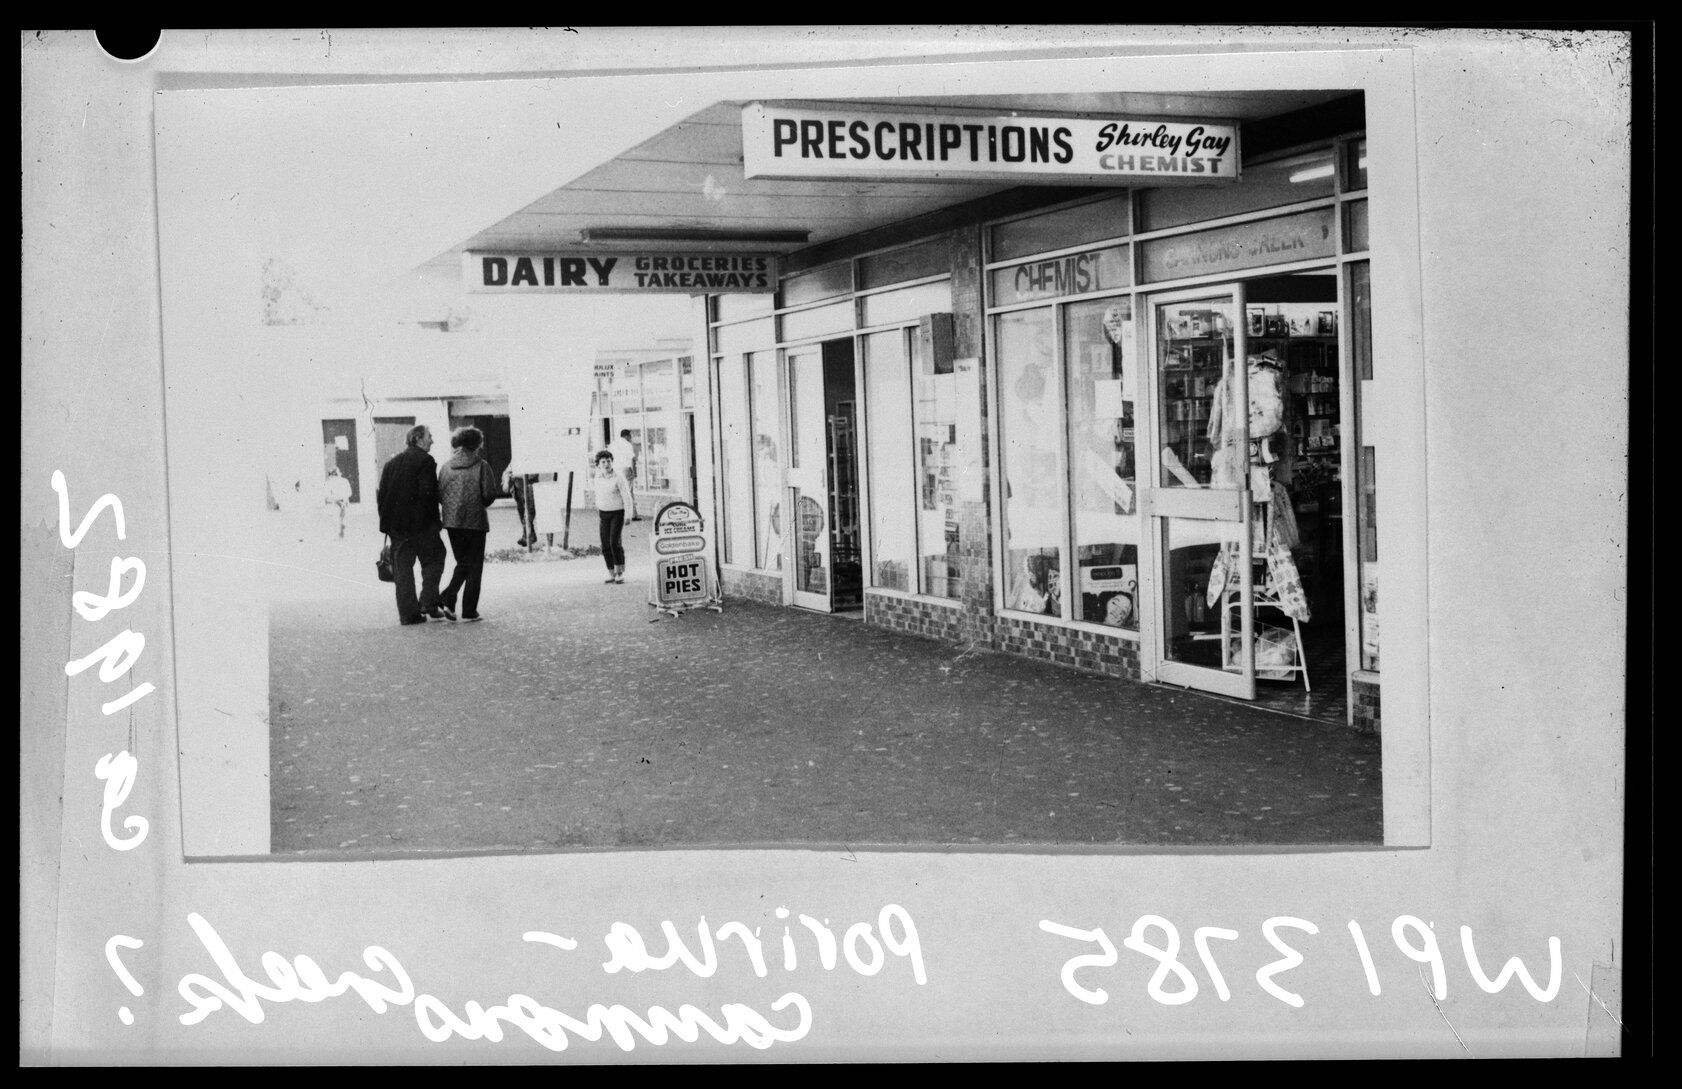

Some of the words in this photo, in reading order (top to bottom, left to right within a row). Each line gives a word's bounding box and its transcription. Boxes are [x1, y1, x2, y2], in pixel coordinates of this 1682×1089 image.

[773, 118, 1074, 164] PRESCRIPTIONS
[1095, 123, 1182, 156] Shirley
[1185, 126, 1231, 157] Gay
[1100, 154, 1222, 173] CHEMIST
[482, 256, 618, 287] DAIRY
[635, 256, 768, 271] GROCERIES
[634, 272, 768, 288] TAKEAWAYS
[1014, 252, 1103, 298] CHEMIST
[666, 563, 699, 579] HOT
[665, 579, 701, 594] PIES
